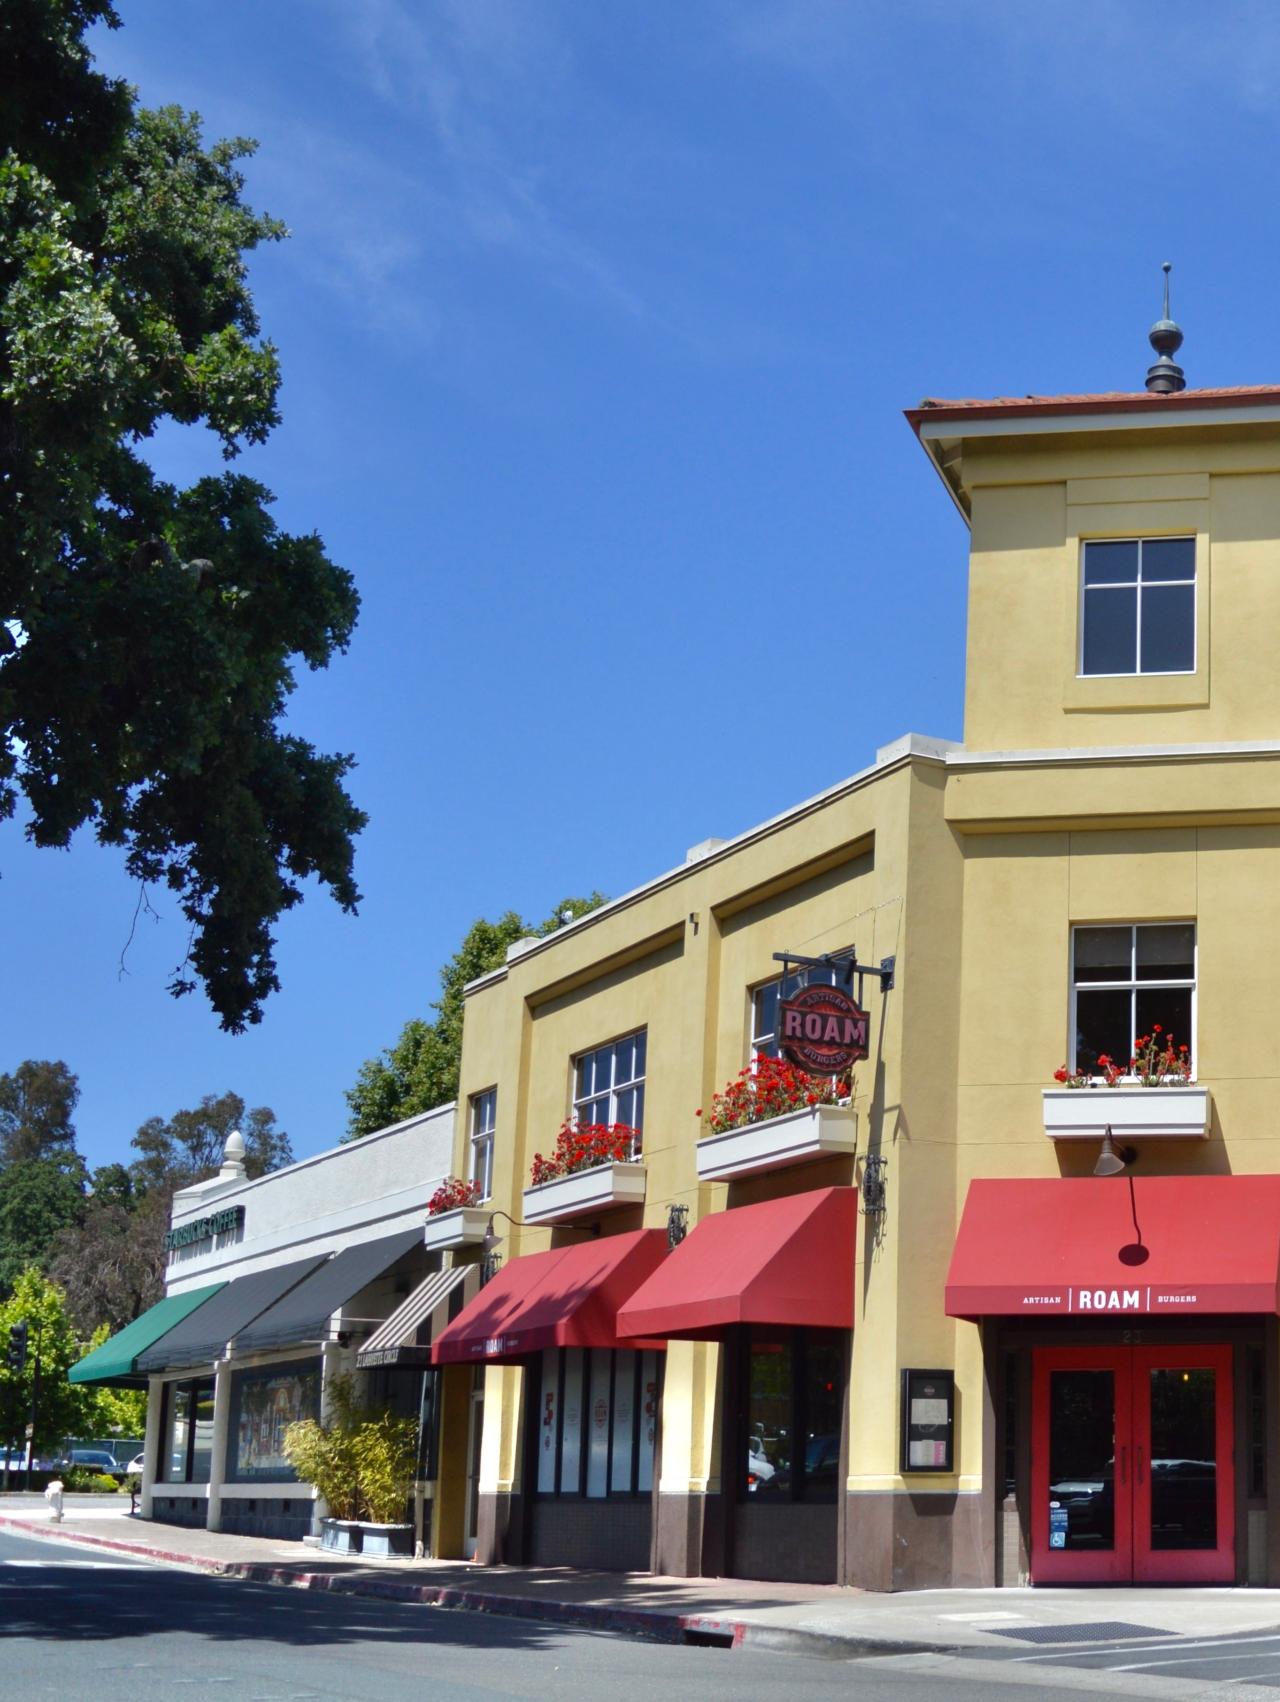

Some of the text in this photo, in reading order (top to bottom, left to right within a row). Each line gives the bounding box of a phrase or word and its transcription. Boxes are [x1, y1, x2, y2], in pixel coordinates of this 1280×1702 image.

[807, 992, 849, 1011] ARTISAN
[785, 1010, 866, 1045] ROAM
[803, 1047, 848, 1065] BURGERS
[209, 1205, 237, 1236] COFFEE
[1023, 1290, 1197, 1309] ARTISAN ROAM BURGERS
